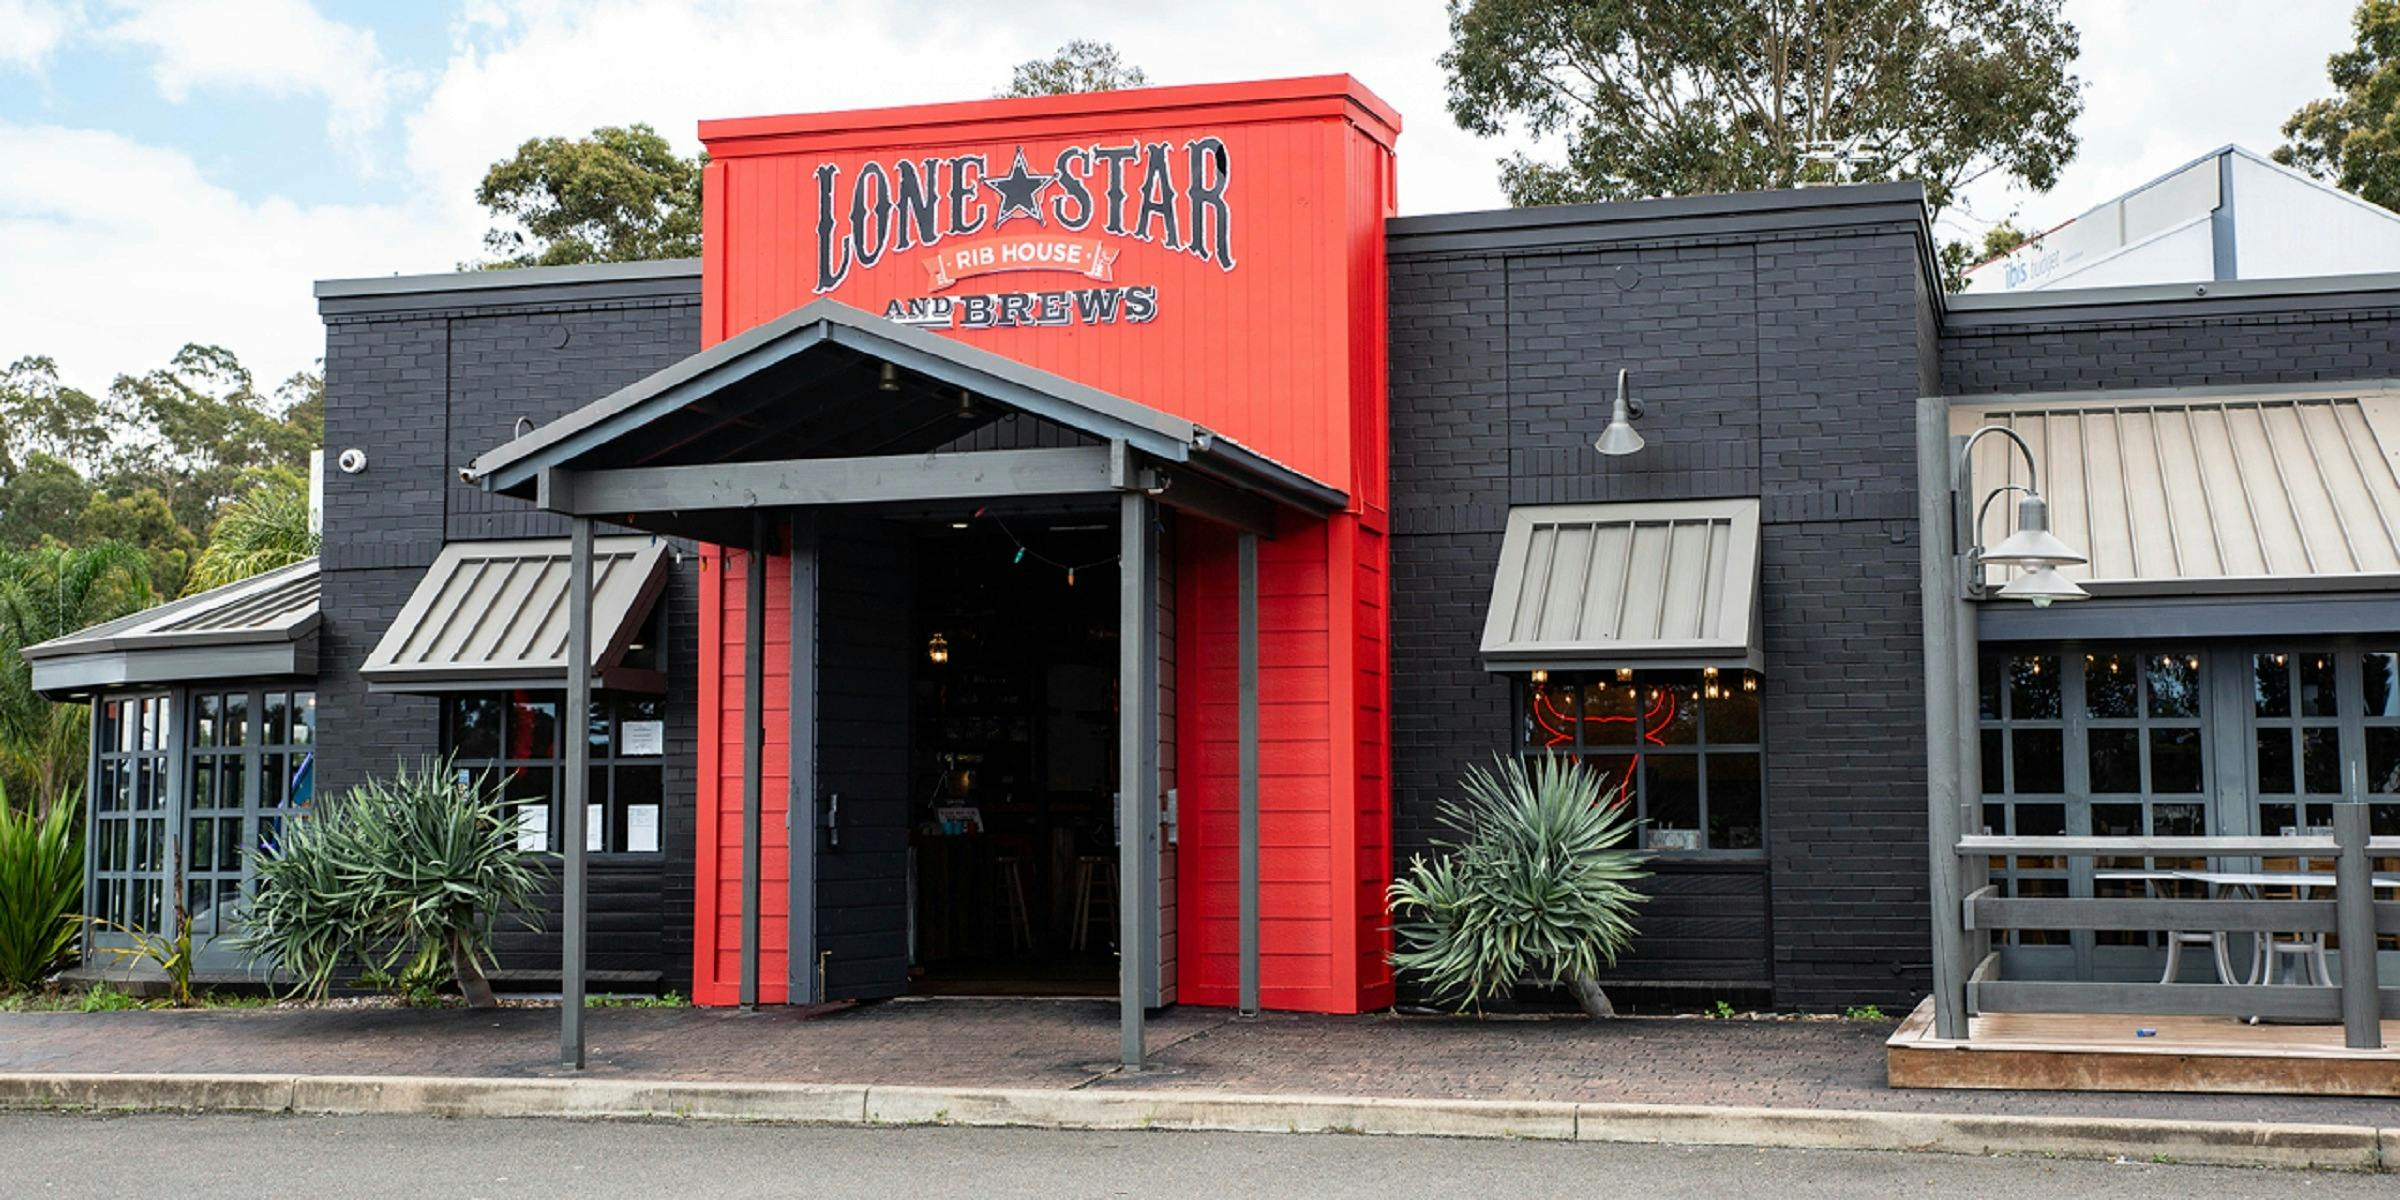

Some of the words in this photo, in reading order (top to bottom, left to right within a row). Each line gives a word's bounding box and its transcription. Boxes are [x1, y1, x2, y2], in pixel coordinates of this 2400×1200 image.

[813, 154, 987, 293] LONE
[1051, 136, 1236, 271] STAR
[956, 246, 995, 270] RIB
[1002, 241, 1083, 264] HOUSE
[882, 295, 953, 320] AND
[960, 286, 1158, 328] BREWS
